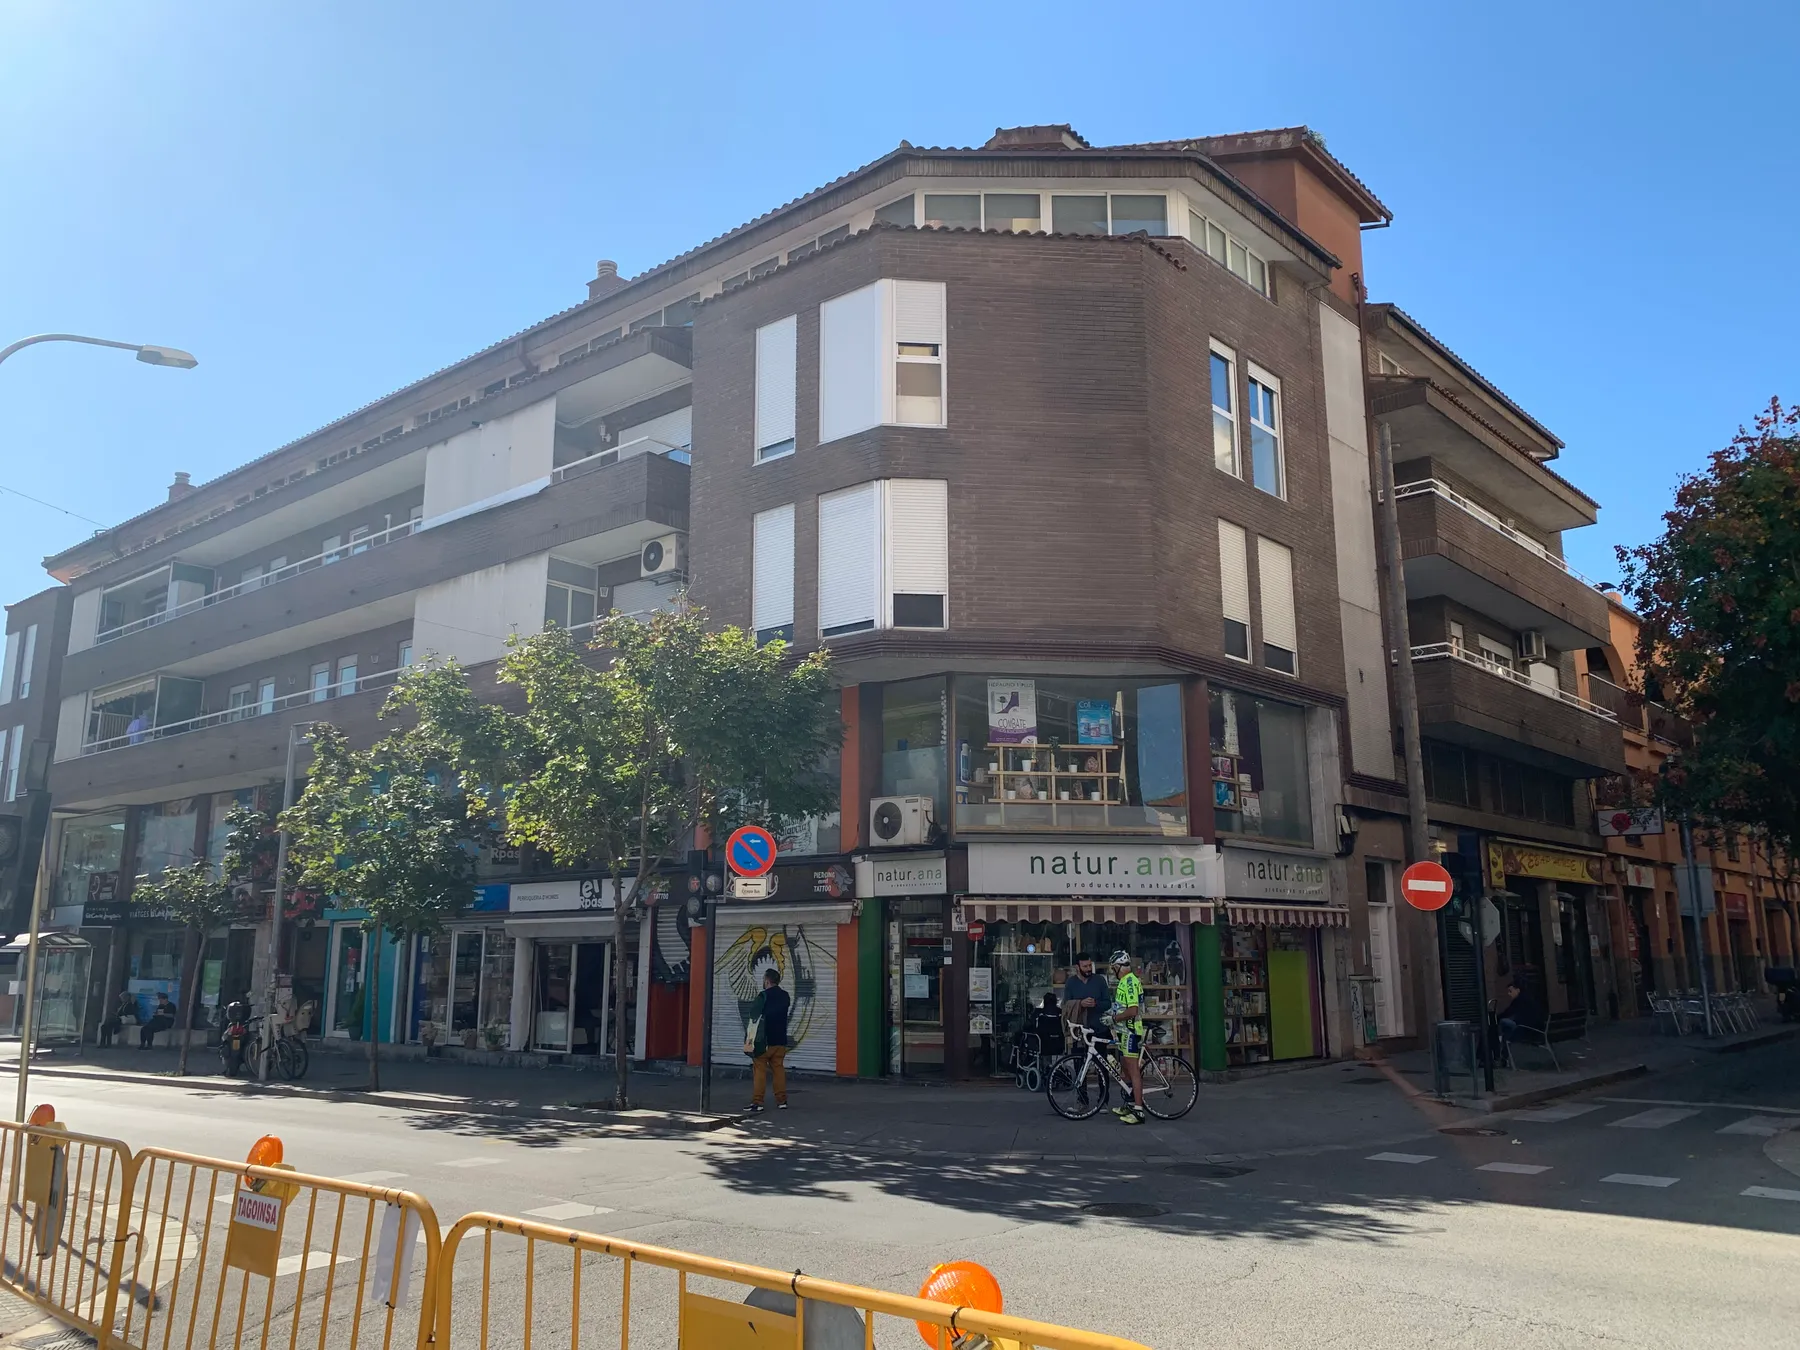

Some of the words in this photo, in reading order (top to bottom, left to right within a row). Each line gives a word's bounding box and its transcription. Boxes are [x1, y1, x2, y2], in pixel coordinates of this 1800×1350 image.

[1029, 850, 1196, 876] natur.ana
[1246, 859, 1324, 884] natur.ana
[877, 868, 943, 882] natur.ana
[581, 879, 600, 898] el
[813, 885, 832, 893] TATTOO
[1066, 881, 1133, 889] productes
[238, 1196, 277, 1225] TAGOINSA
